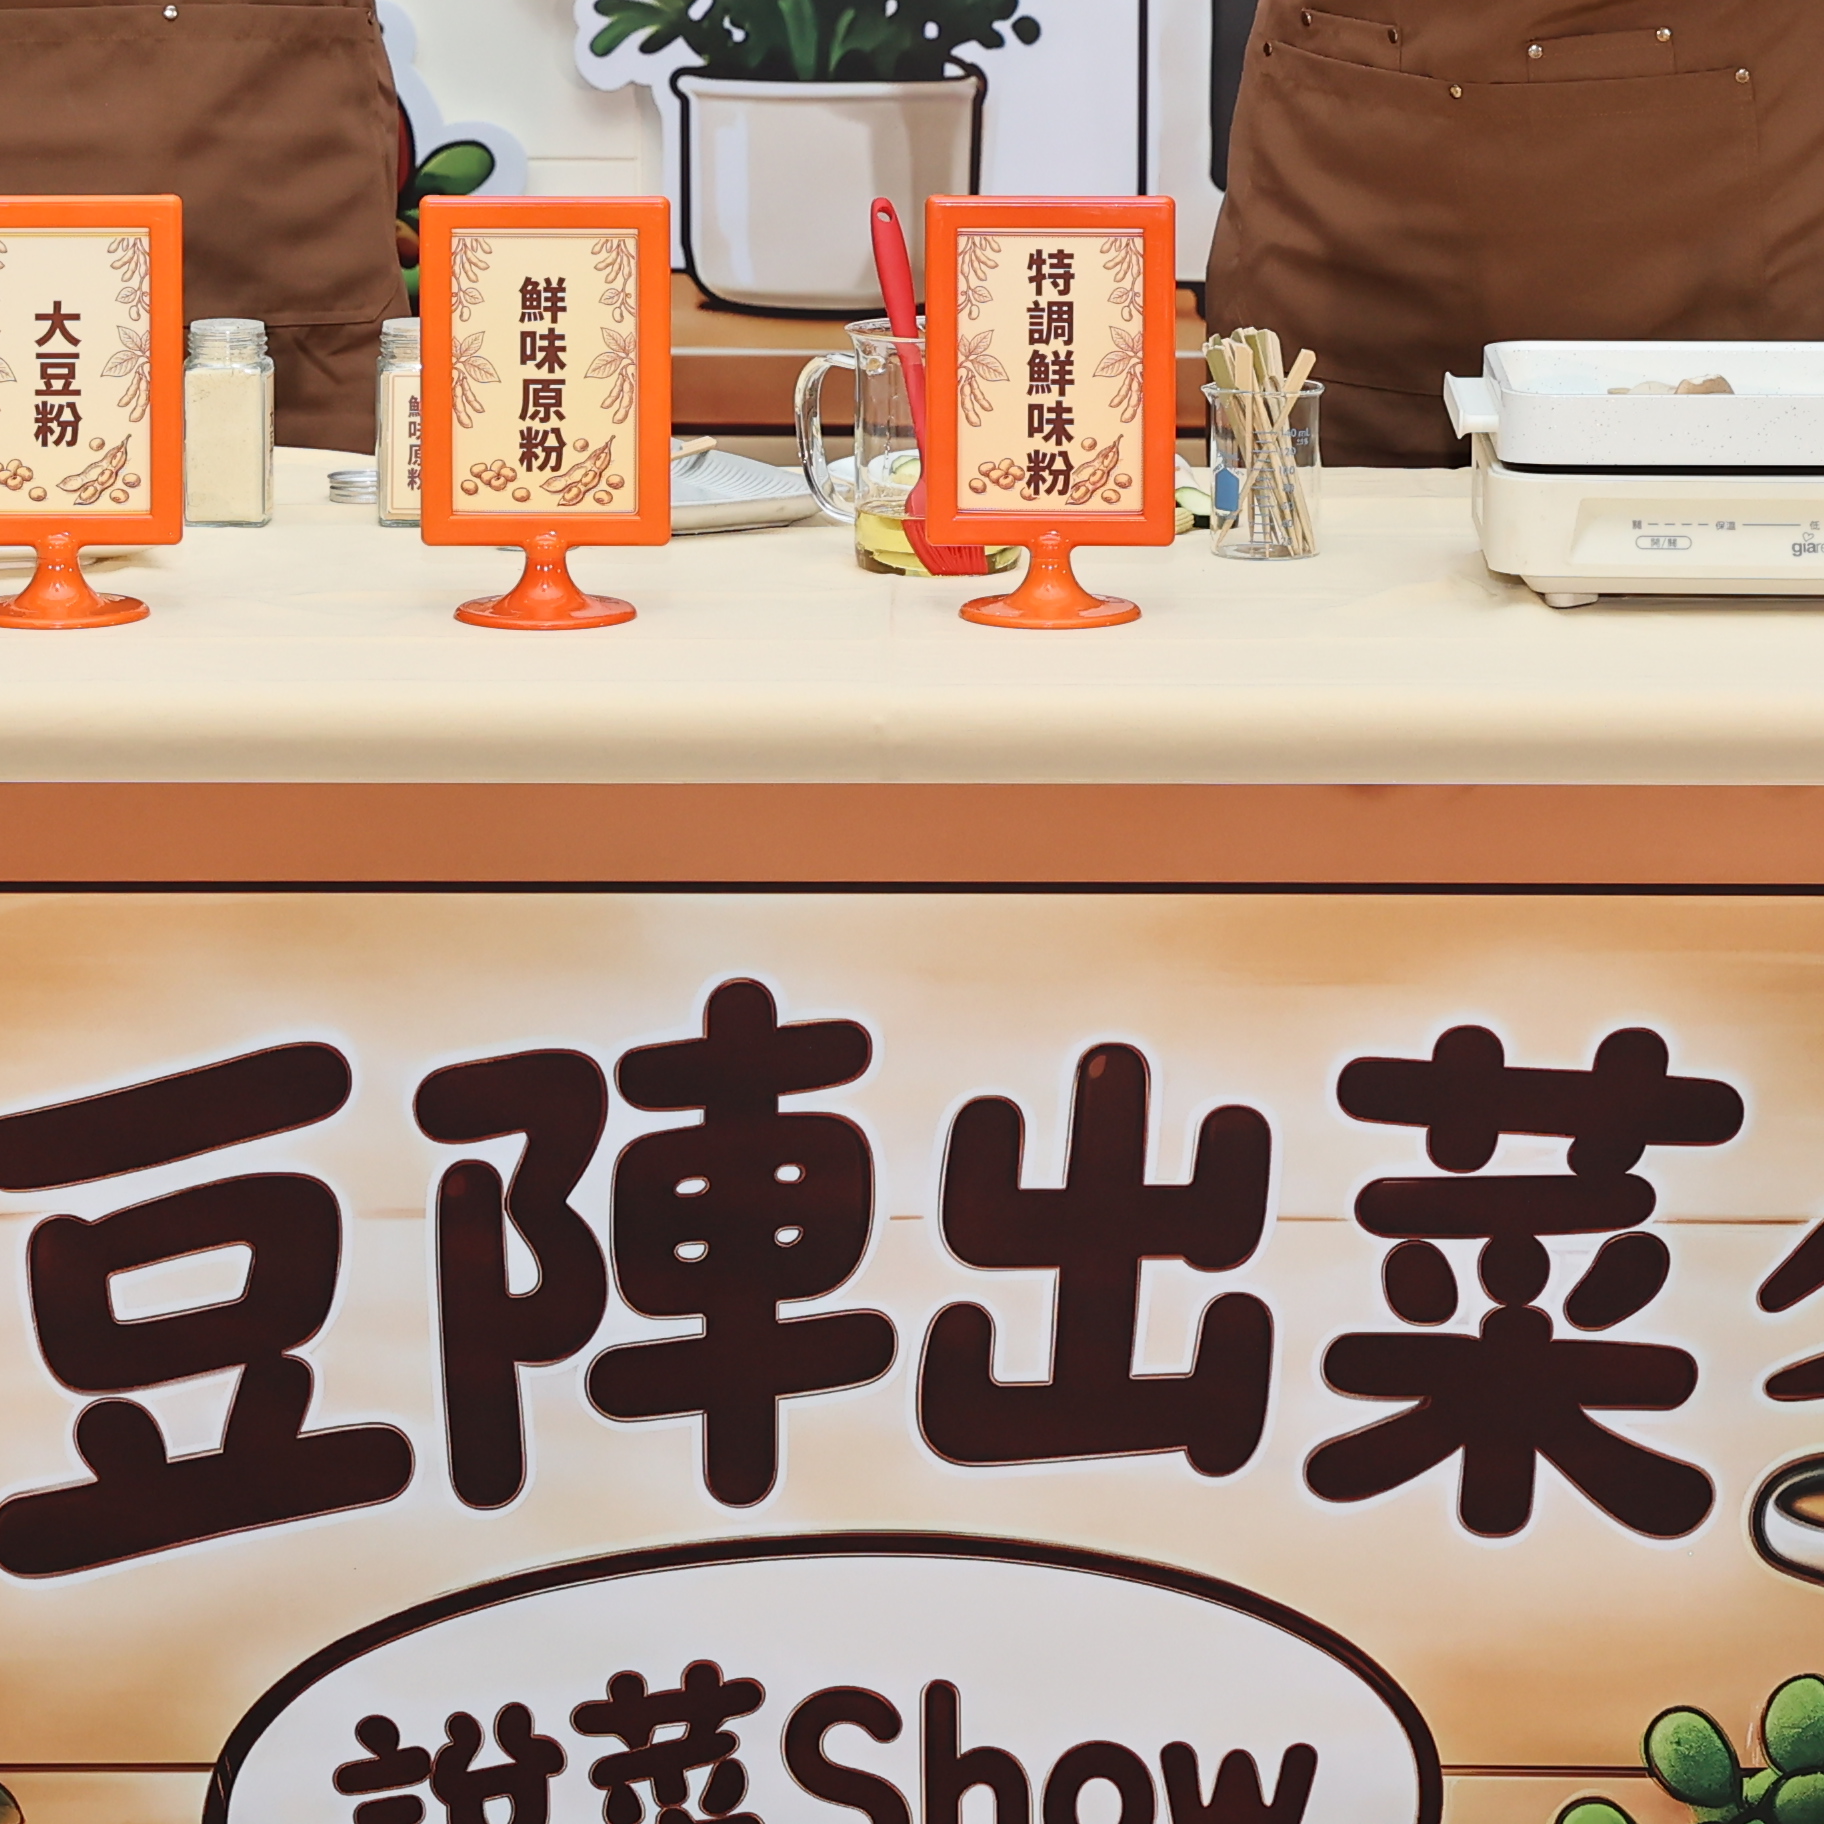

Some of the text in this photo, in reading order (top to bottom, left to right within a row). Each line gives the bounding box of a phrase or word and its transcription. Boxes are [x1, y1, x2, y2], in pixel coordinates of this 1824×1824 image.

[34, 301, 83, 448] 大豆粉
[518, 277, 567, 474] 鮮味原粉
[1026, 249, 1075, 496] 特調鮮味粉
